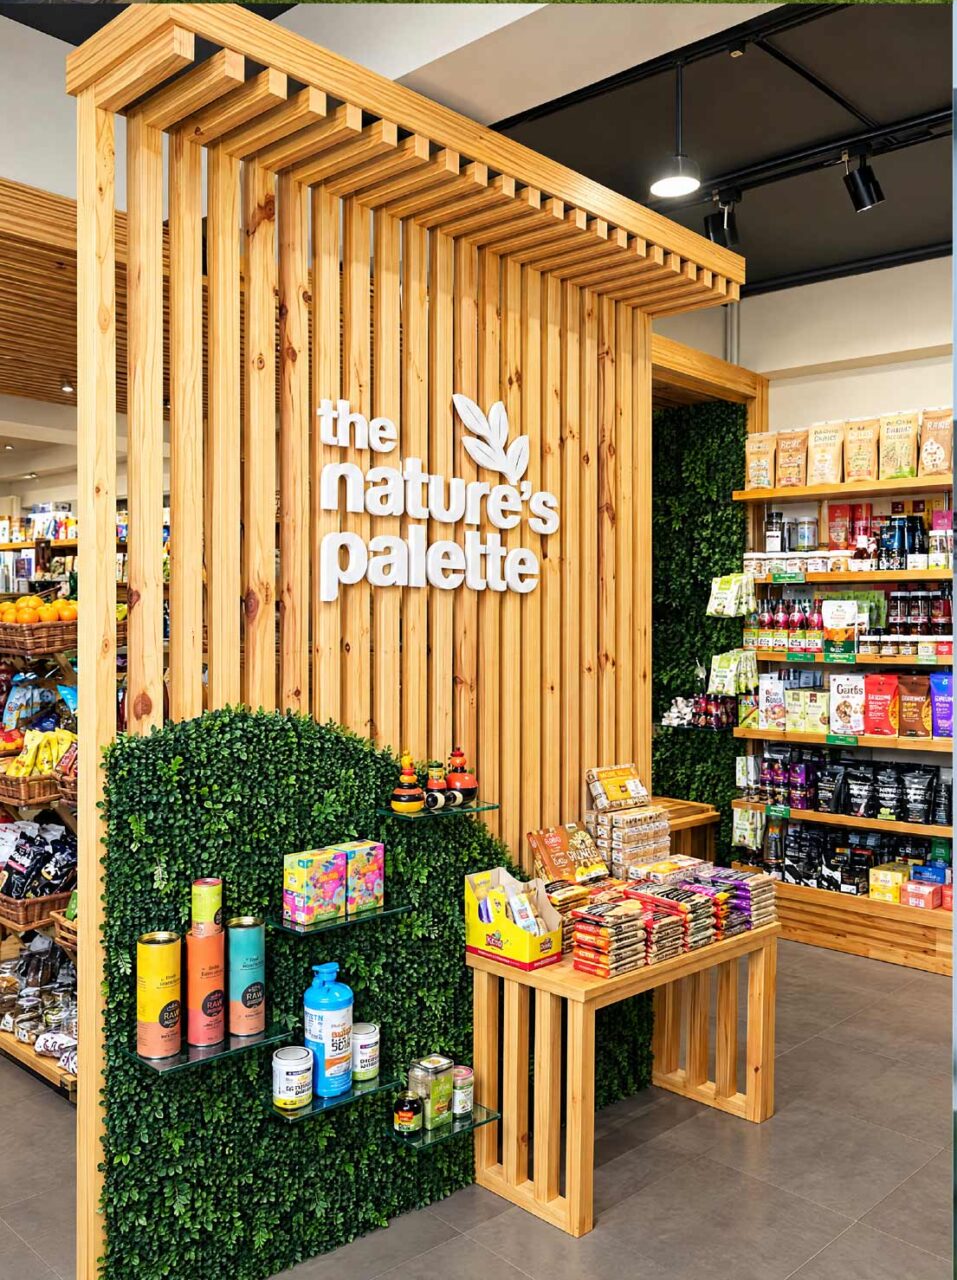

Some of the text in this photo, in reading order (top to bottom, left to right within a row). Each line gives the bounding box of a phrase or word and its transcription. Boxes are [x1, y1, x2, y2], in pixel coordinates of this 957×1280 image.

[317, 399, 398, 453] the
[320, 456, 560, 535] nature's
[320, 524, 540, 602] palette
[207, 1000, 223, 1009] RAW
[246, 991, 263, 1001] RAW
[163, 1009, 179, 1020] RAW
